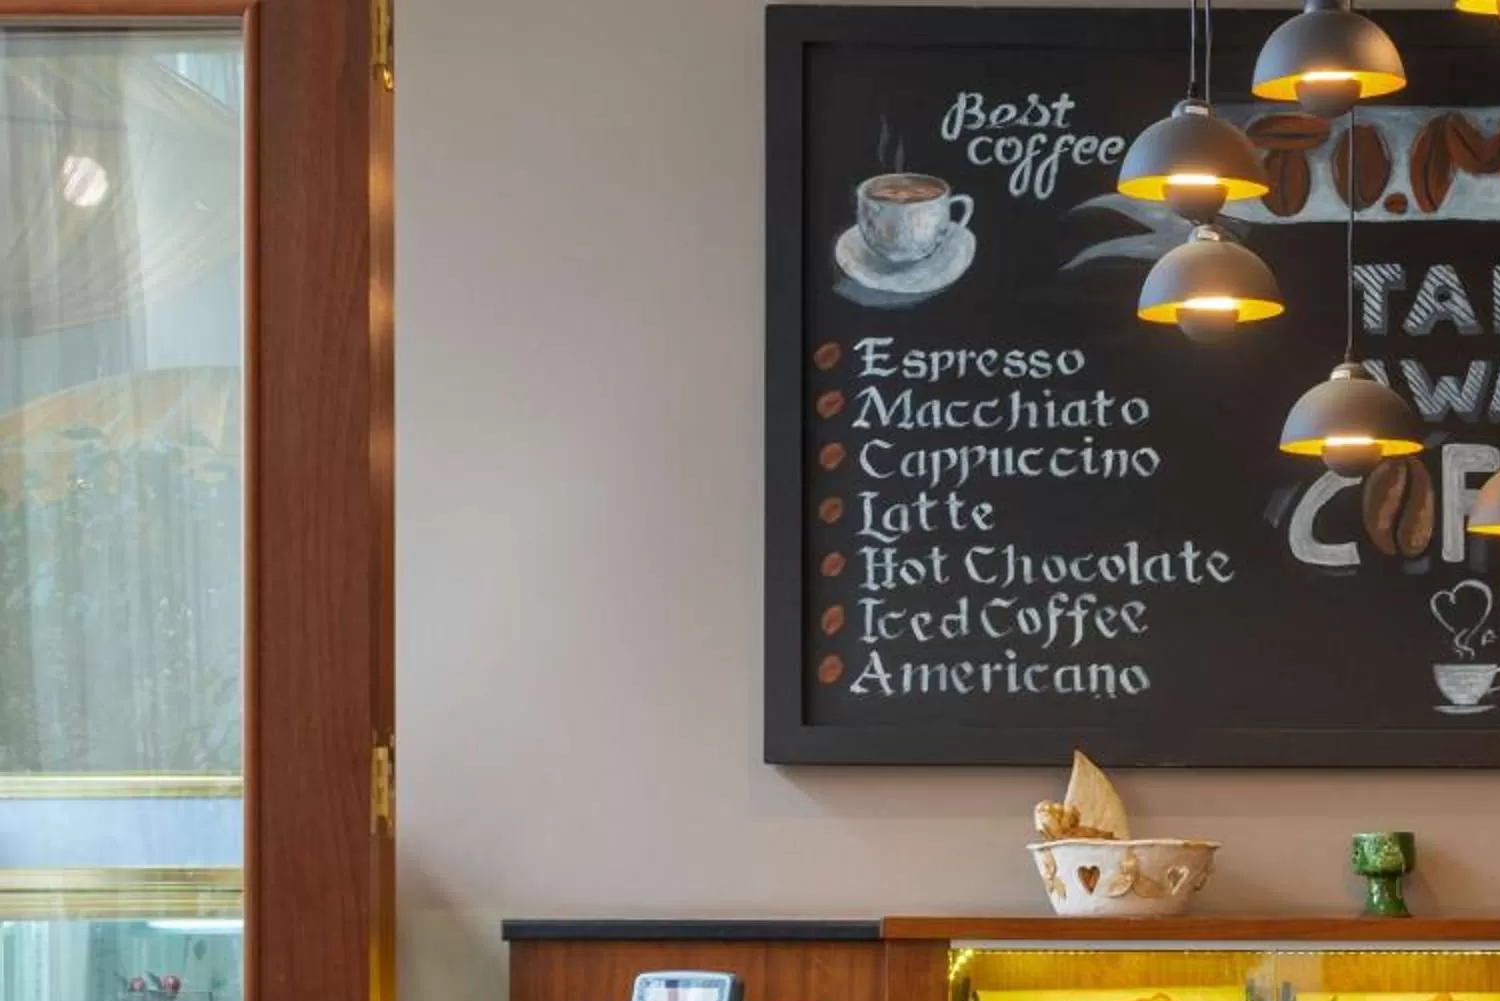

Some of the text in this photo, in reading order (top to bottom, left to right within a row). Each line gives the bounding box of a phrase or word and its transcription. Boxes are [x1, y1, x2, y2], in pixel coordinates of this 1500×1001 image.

[942, 92, 1076, 141] Best
[853, 336, 1085, 382] Espresso
[851, 385, 1149, 430] Macchiato
[859, 435, 1161, 488] Cappuccino
[857, 490, 994, 544] Latte
[857, 541, 1236, 591] Hot Chocolate
[859, 592, 1149, 649] Iced Coffee
[849, 649, 1151, 699] Americano
